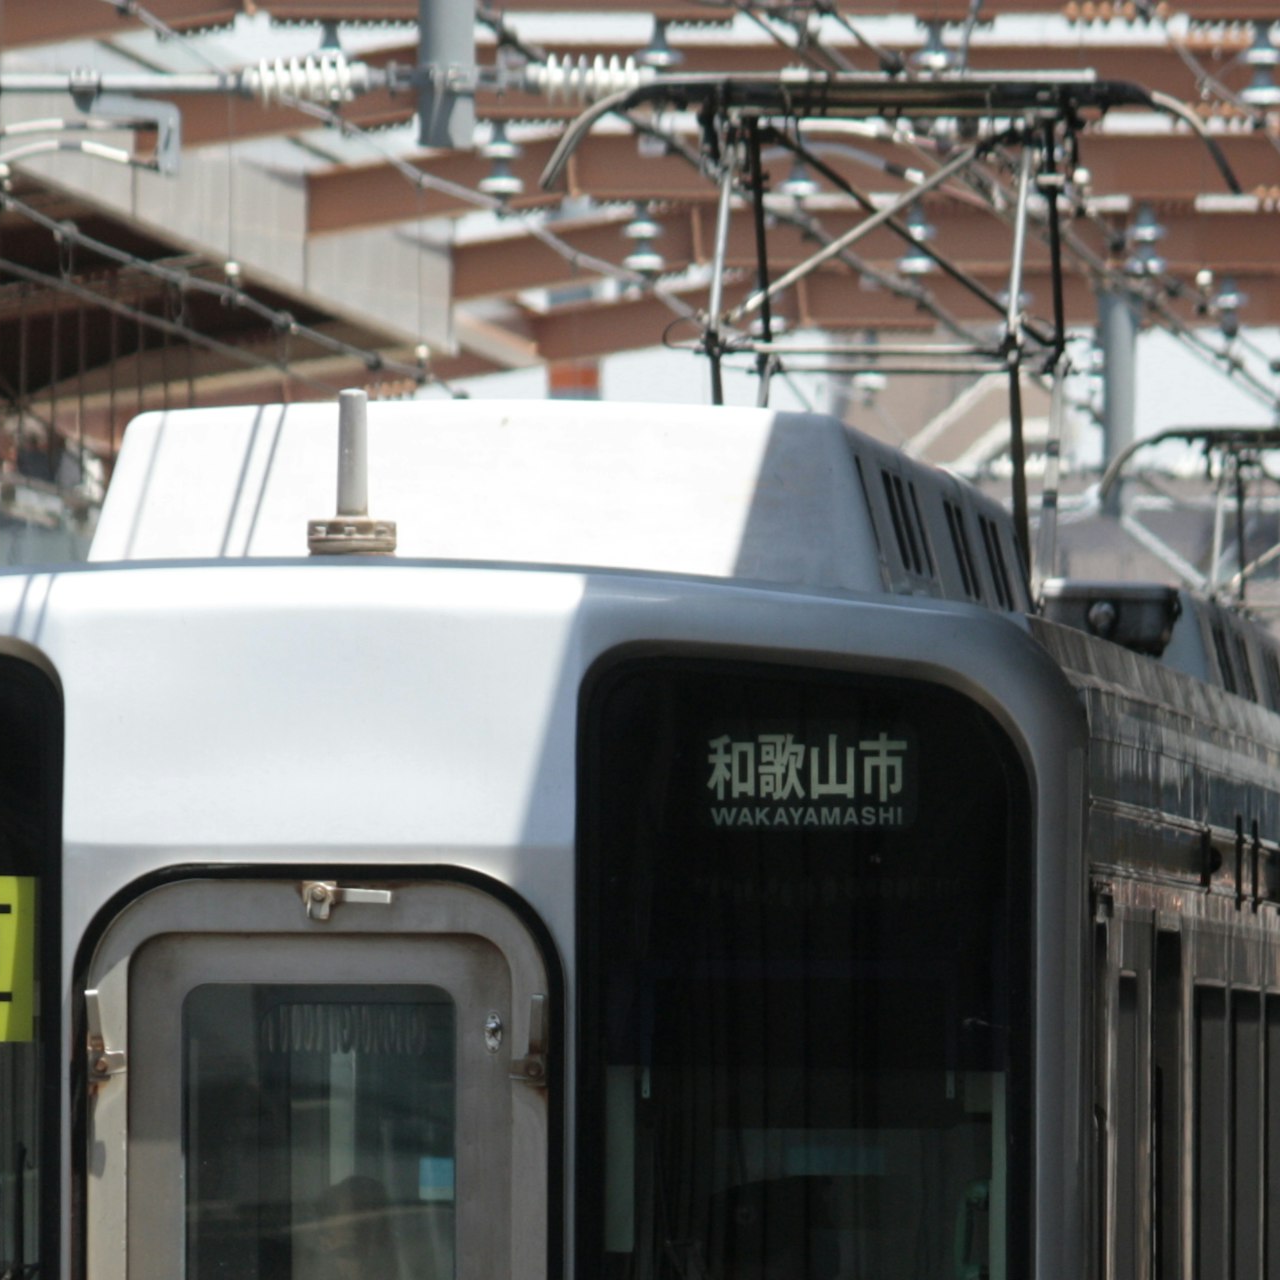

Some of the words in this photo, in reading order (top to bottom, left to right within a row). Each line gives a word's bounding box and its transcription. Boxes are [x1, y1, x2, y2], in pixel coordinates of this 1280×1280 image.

[706, 732, 908, 802] 和歌山市
[710, 806, 904, 826] WAKAYAMASHI
